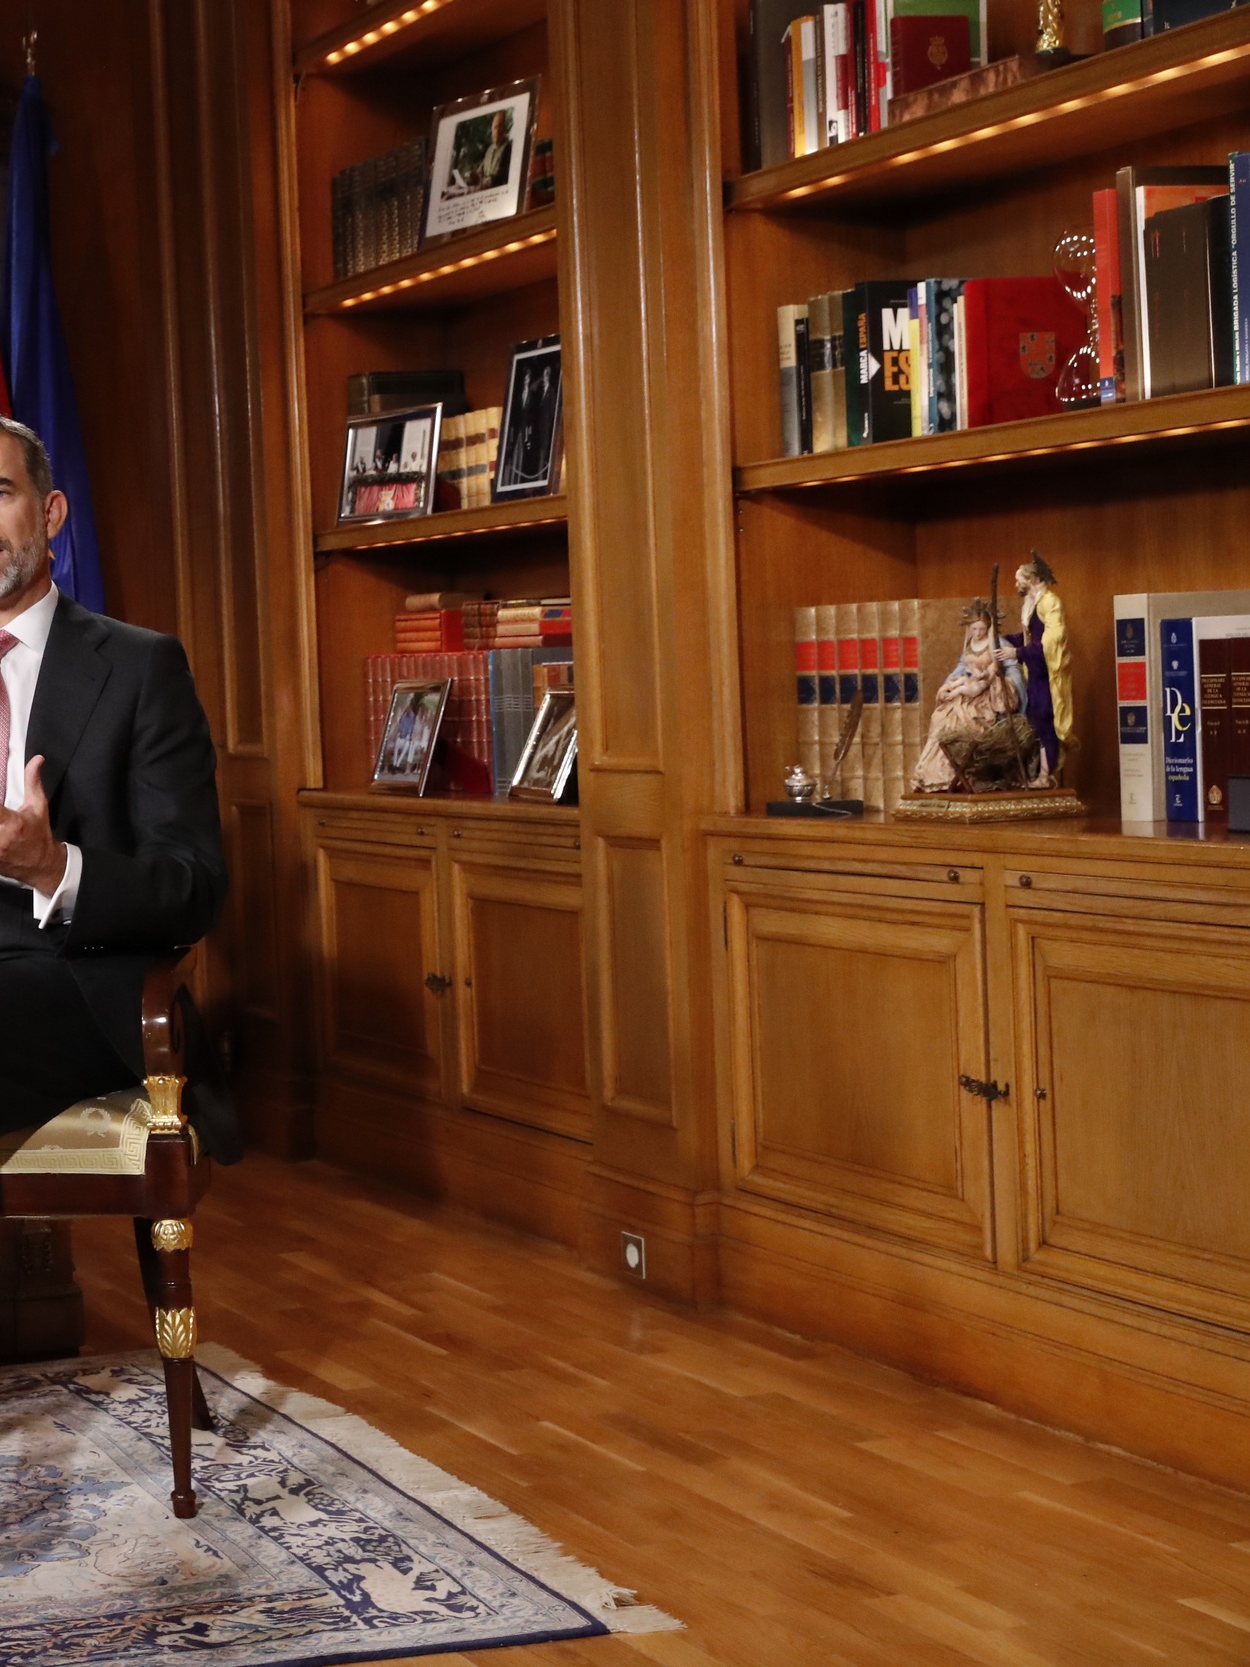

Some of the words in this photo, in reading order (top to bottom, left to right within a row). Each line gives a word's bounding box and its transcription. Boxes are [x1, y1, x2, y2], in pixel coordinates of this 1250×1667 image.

[1230, 194, 1236, 206] DE
[858, 313, 868, 348] ESPAÑA
[860, 350, 868, 384] MARCA
[1166, 756, 1194, 764] Diccionario
[1168, 774, 1190, 782] española
